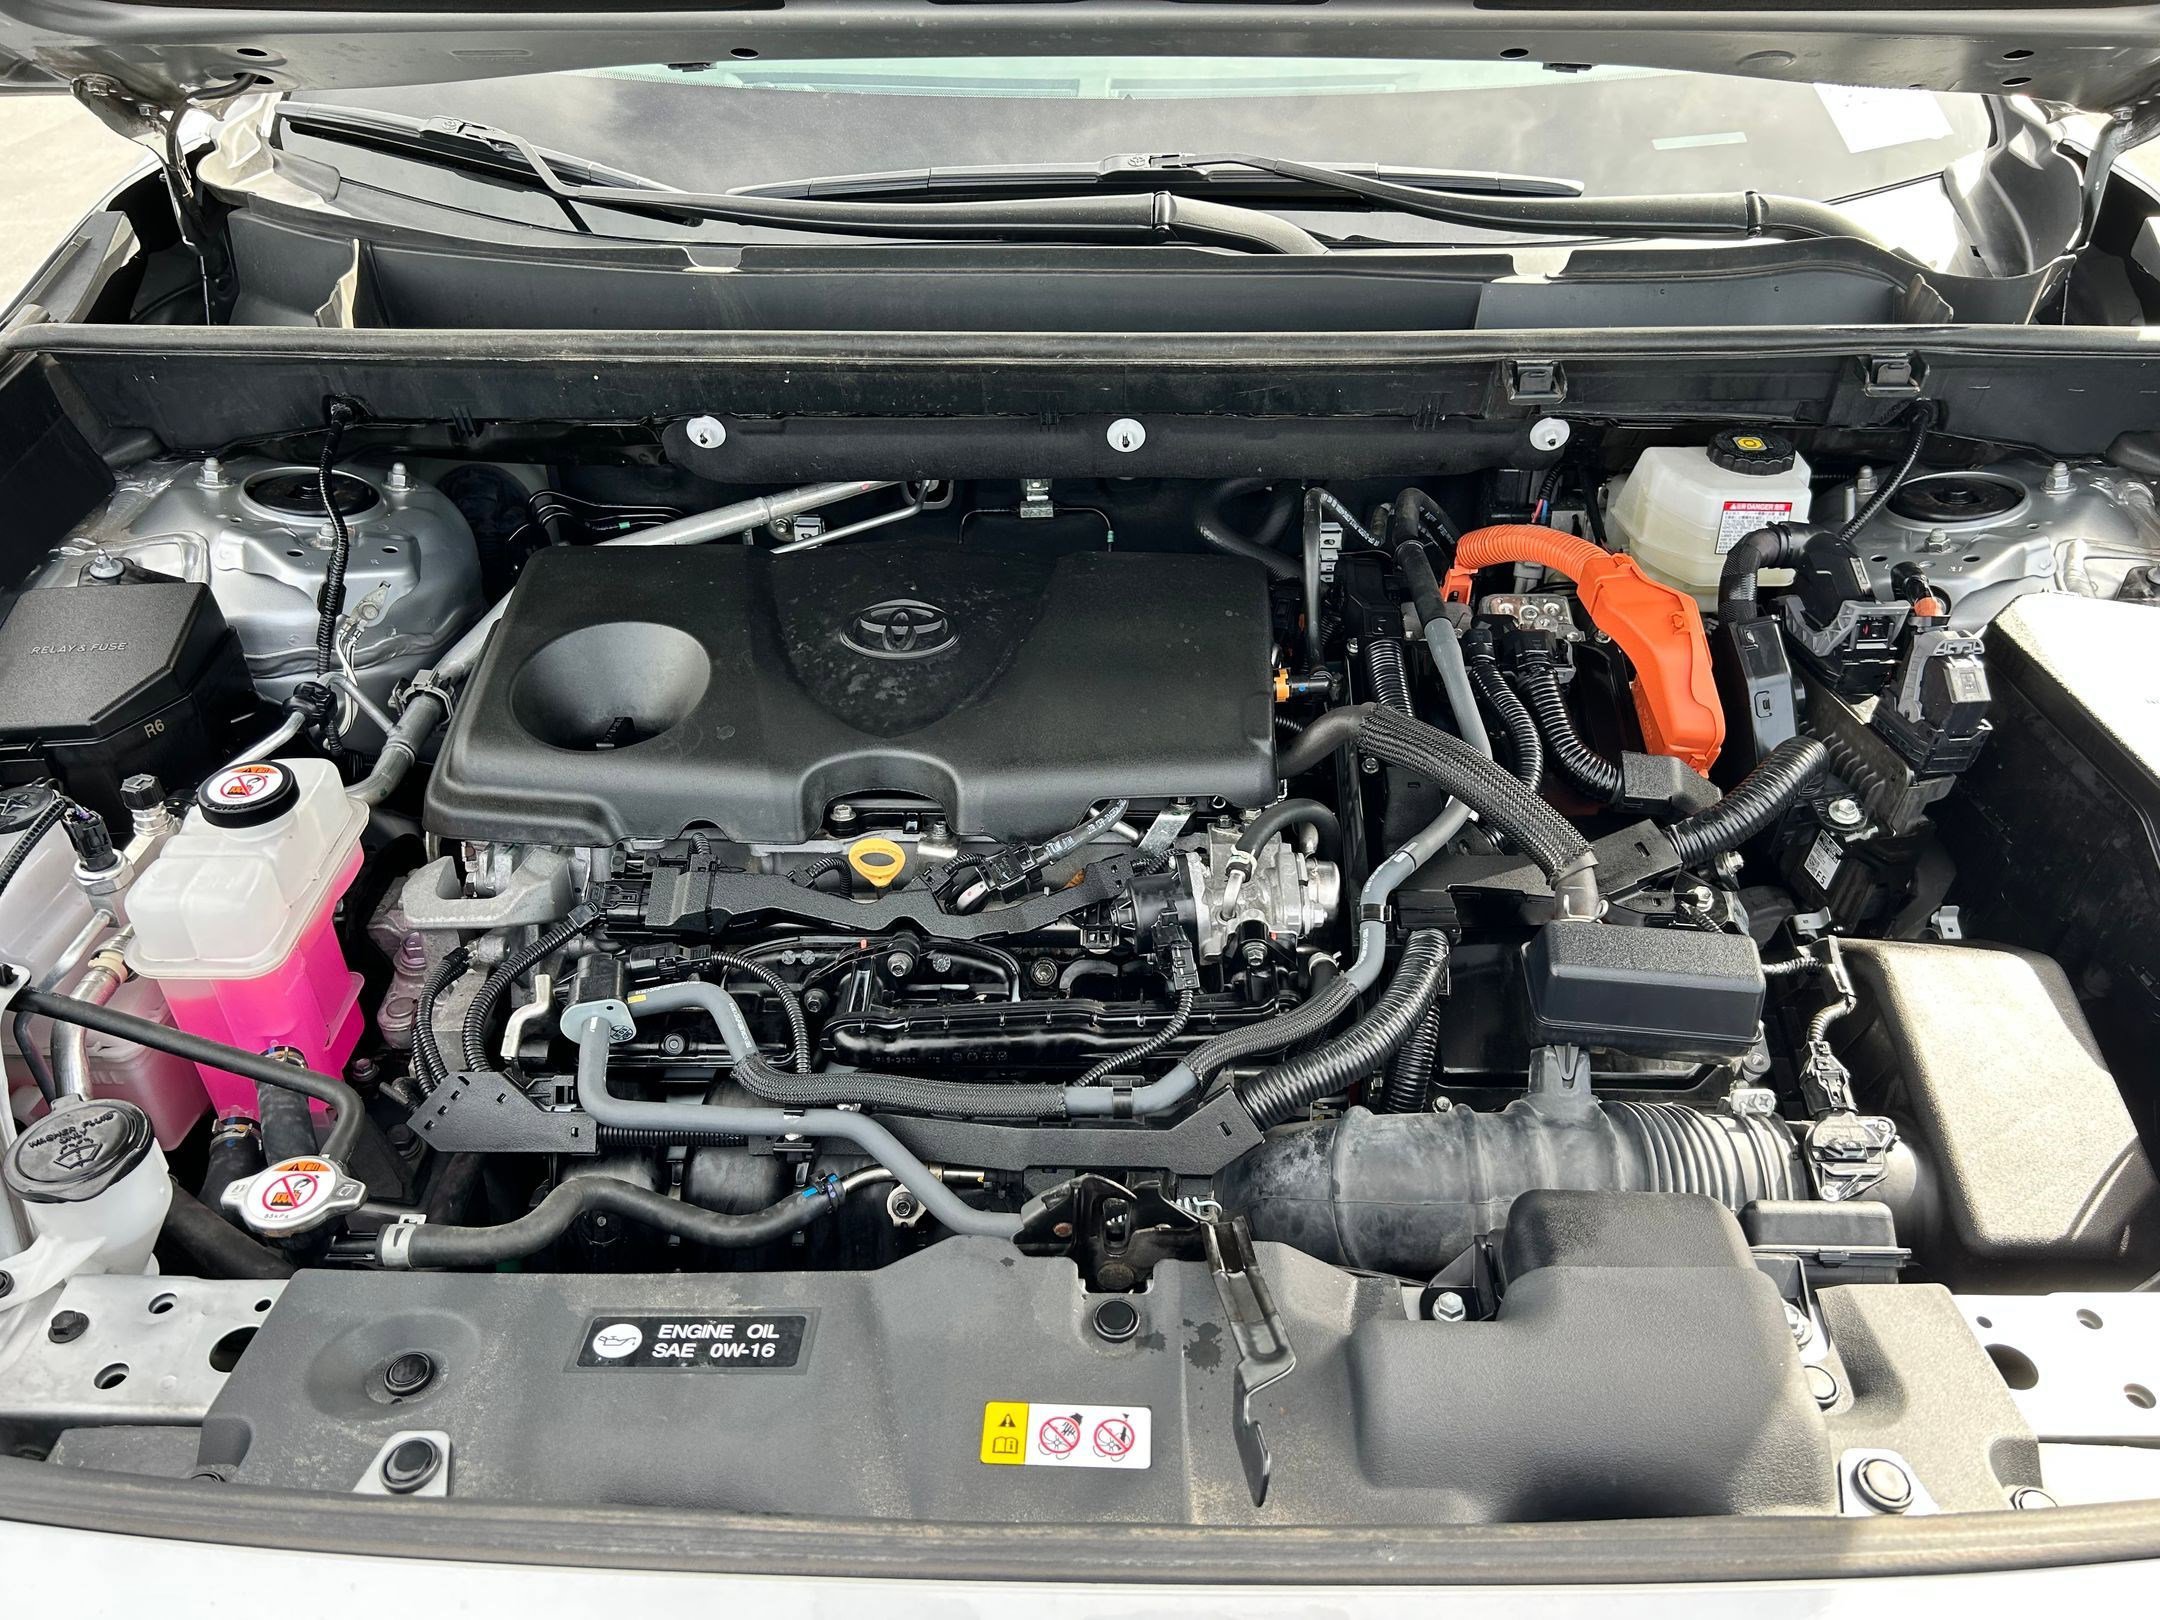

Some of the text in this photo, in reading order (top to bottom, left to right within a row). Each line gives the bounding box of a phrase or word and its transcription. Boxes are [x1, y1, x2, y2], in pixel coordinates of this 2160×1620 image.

[30, 644, 77, 655] RELAY
[90, 642, 128, 652] FUSE
[143, 718, 166, 738] R6
[28, 1110, 116, 1149] WASHER FLUID
[59, 1128, 88, 1144] ONLY
[657, 1323, 781, 1340] ENGINE OIL
[651, 1342, 777, 1359] SAE 0W-16
